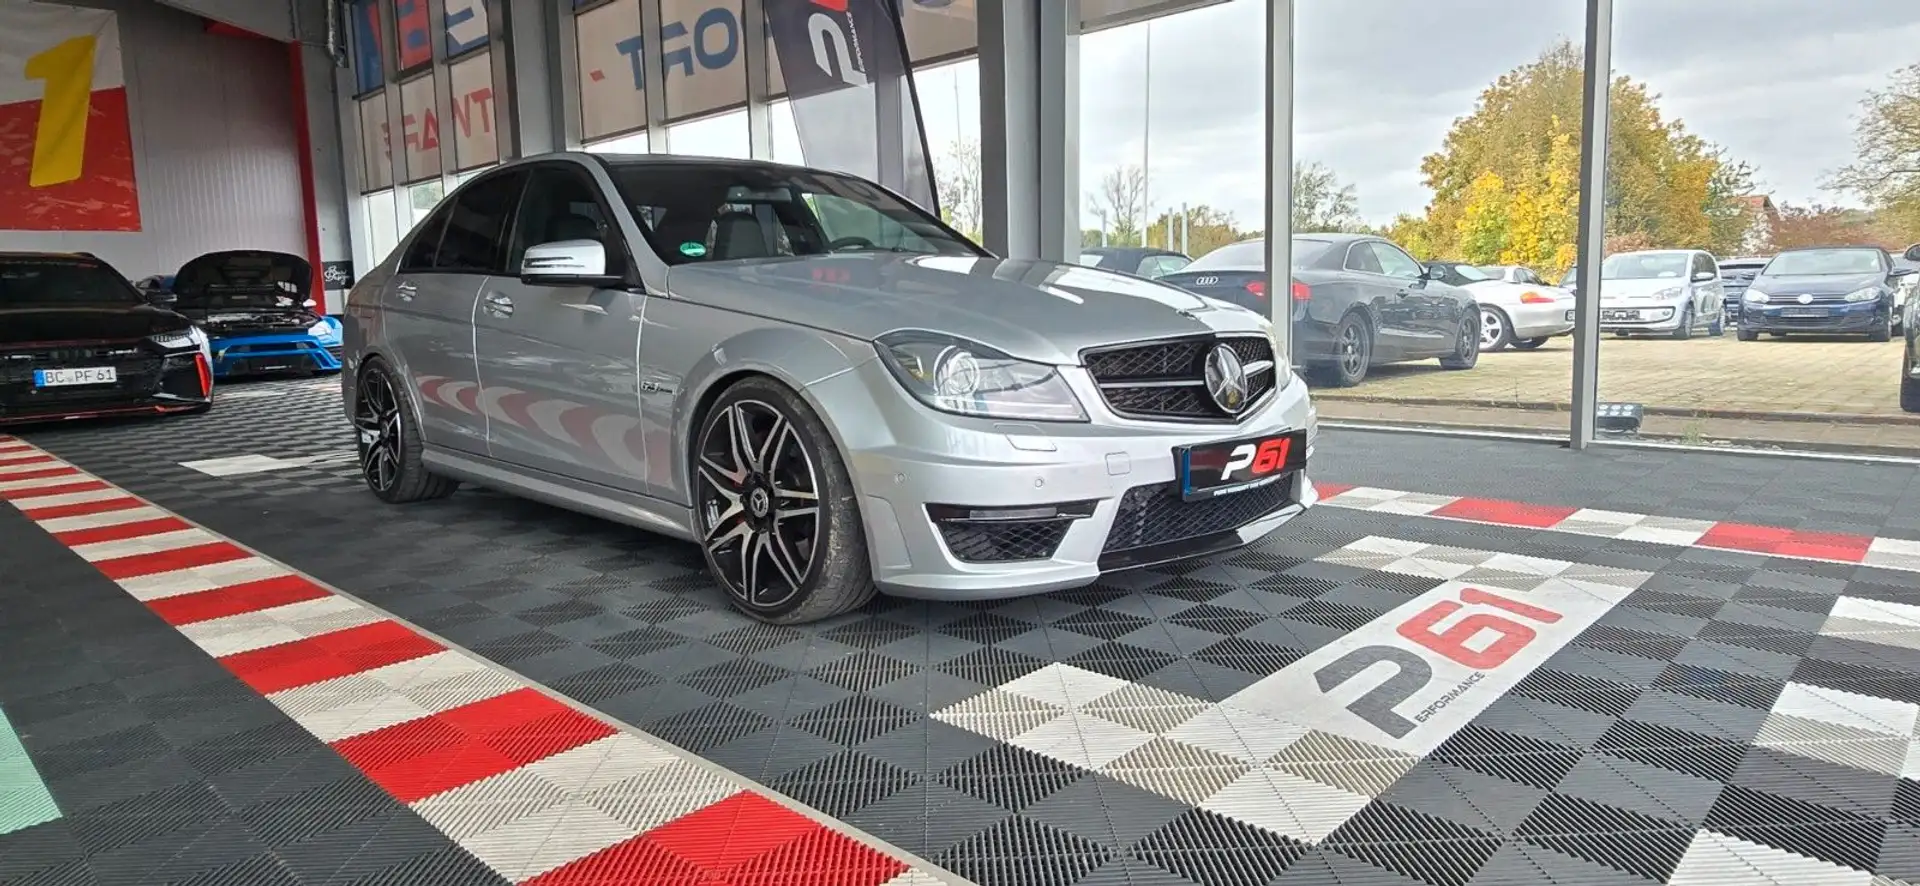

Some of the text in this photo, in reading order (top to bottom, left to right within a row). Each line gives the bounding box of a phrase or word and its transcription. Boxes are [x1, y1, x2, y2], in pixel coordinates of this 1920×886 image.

[24, 34, 97, 188] 1
[45, 368, 114, 384] BC PF 61
[1220, 437, 1292, 481] P61
[1313, 588, 1564, 740] P61
[1414, 671, 1486, 723] ERFORMANCE
